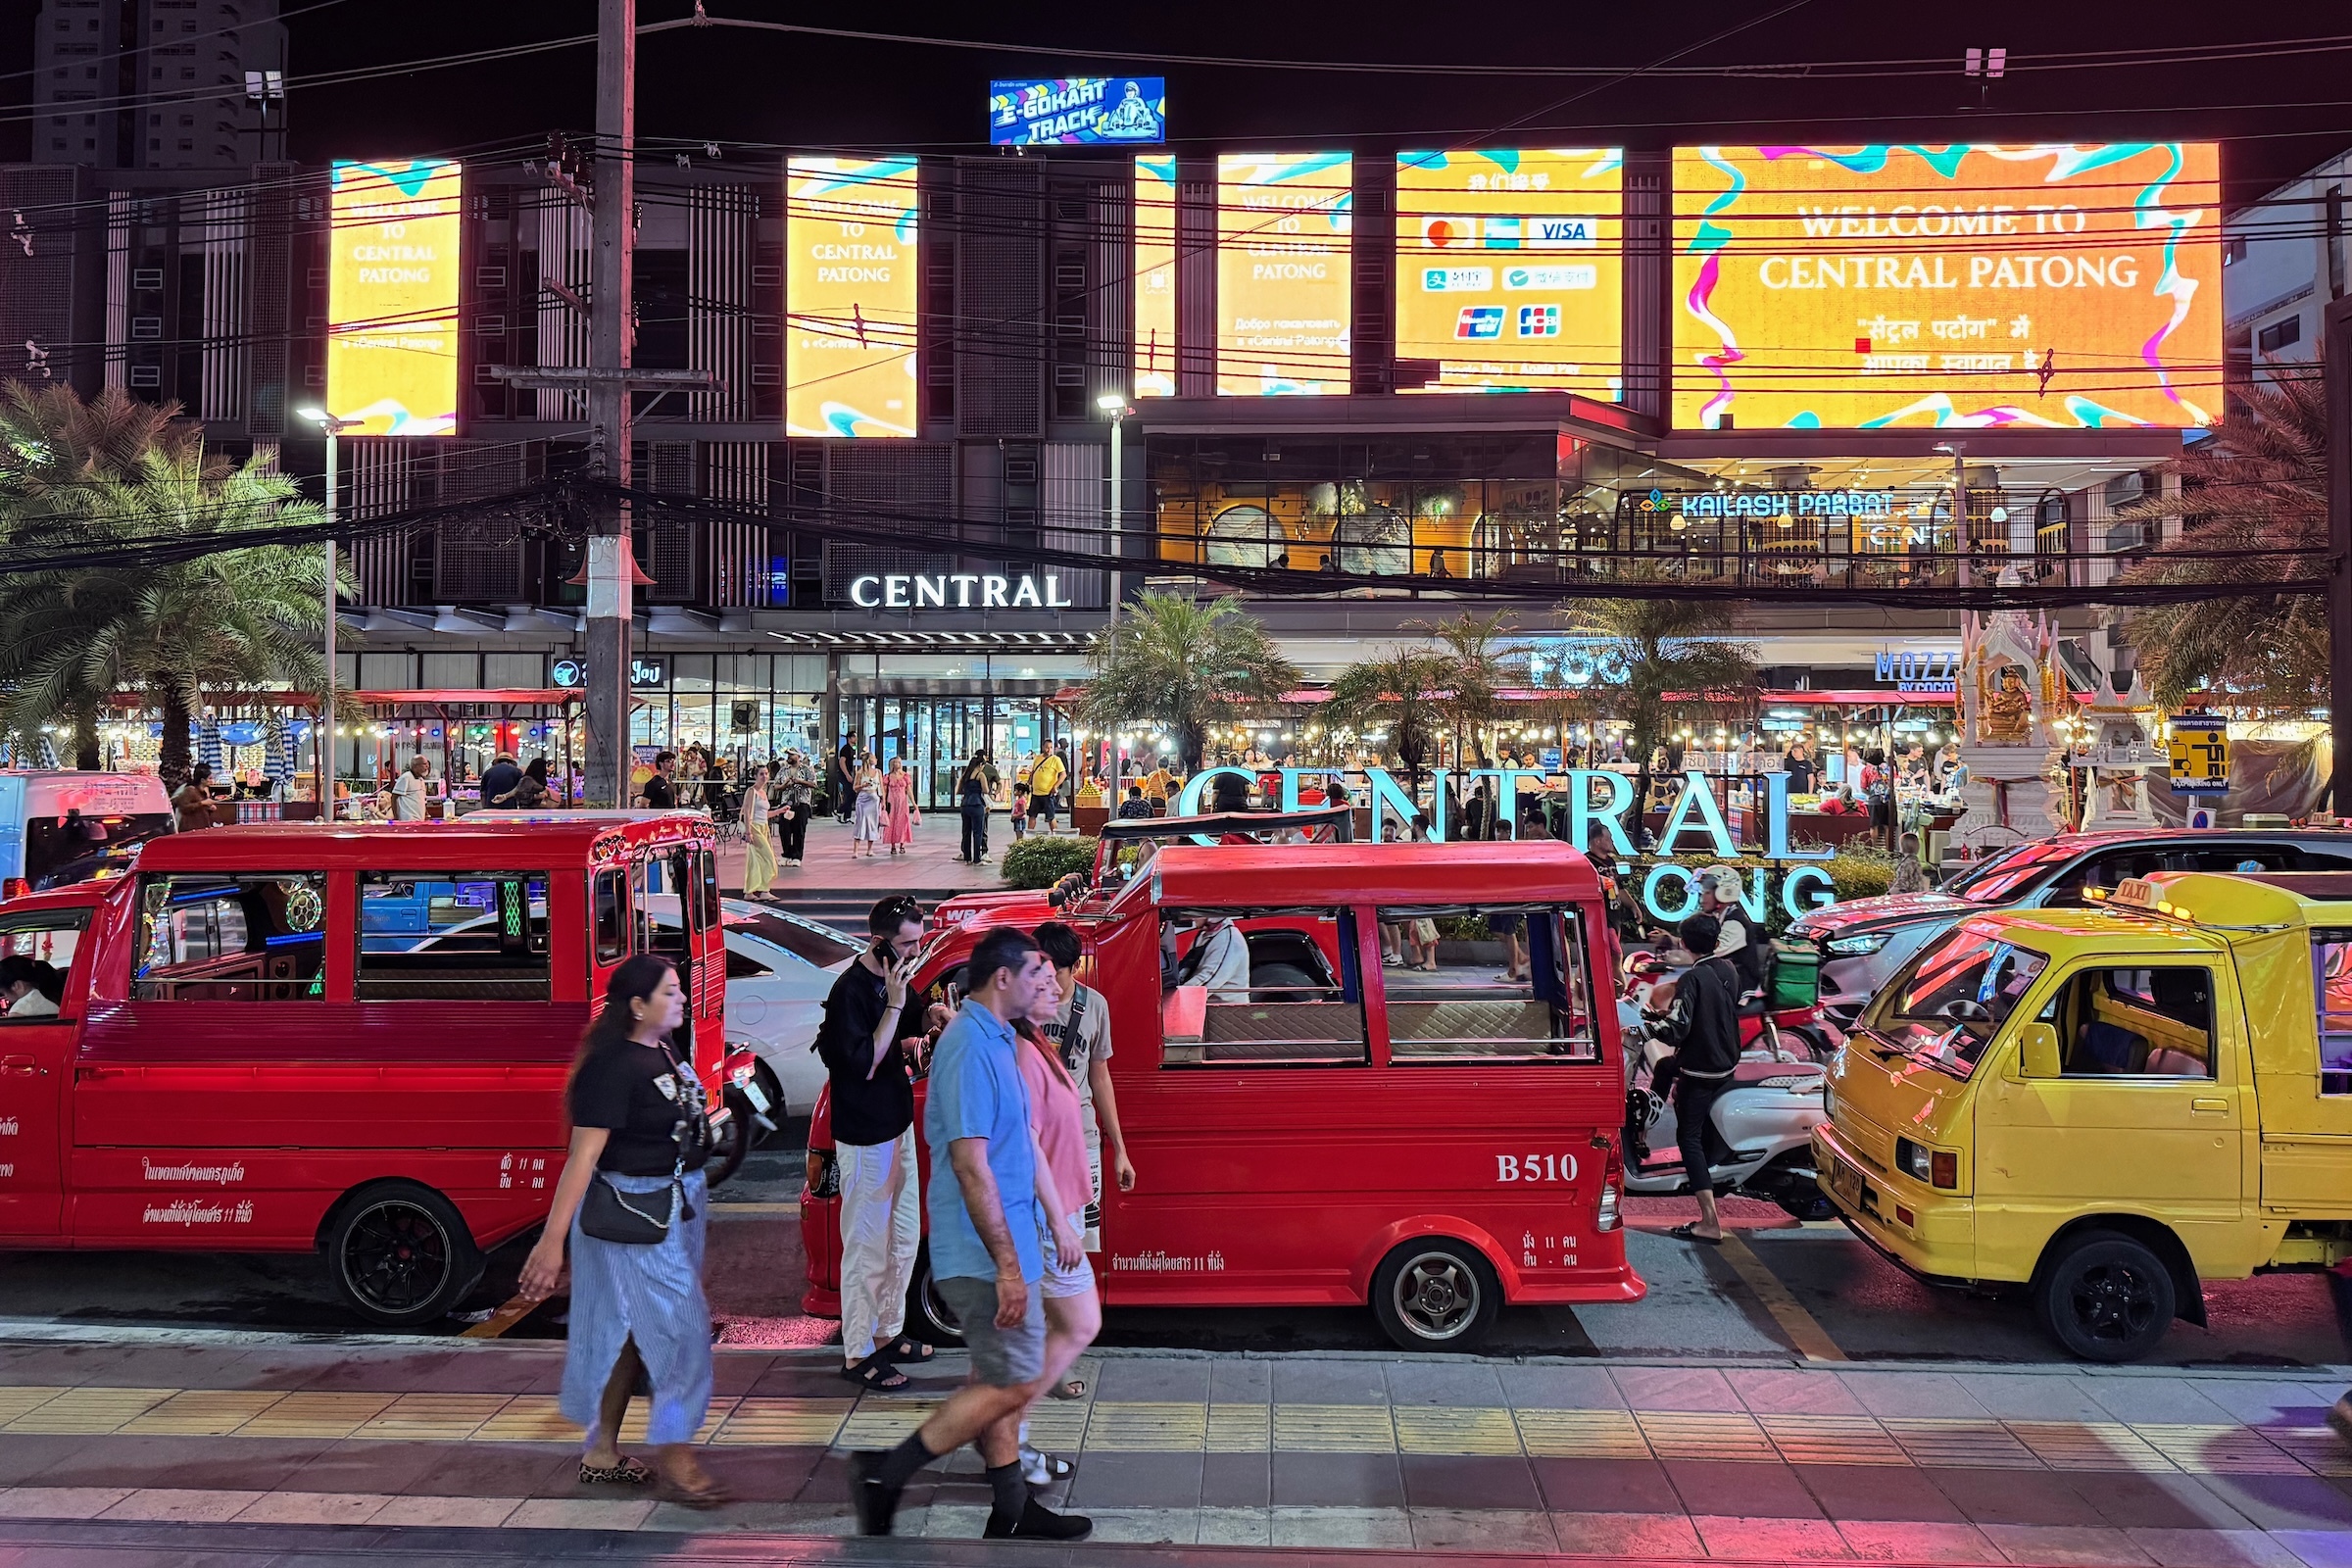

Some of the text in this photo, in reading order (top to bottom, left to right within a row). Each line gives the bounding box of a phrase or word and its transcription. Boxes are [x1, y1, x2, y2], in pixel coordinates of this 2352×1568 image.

[997, 80, 1108, 126] E-GOKART
[1028, 105, 1105, 141] TRACK
[839, 221, 864, 237] TO
[1277, 219, 1300, 233] TO
[1796, 204, 2086, 237] WELCOME TO
[380, 223, 406, 239] TO
[1542, 222, 1586, 240] VISA
[353, 246, 436, 262] CENTRAL
[811, 244, 899, 260] CENTRAL
[359, 268, 430, 283] PATONG
[817, 267, 891, 282] PATONG
[1253, 264, 1327, 280] PATONG
[1759, 254, 2139, 289] CENTRAL PATONG
[1682, 493, 1894, 517] KAILASH PARBAT
[851, 574, 1072, 608] CENTRAL
[1875, 652, 1954, 681] MOZZ
[1178, 765, 1836, 859] CENTRAL
[2120, 881, 2149, 901] TAXI
[518, 1157, 528, 1170] 11
[1495, 1153, 1578, 1182] B510
[223, 1208, 234, 1223] 11
[1522, 1229, 1577, 1249] นั่ง 11 คน
[1112, 1250, 1225, 1274] จำนวนที่นั่งผู้โดยสาร 11 ที่นั่ง
[1523, 1250, 1537, 1267] ยืน
[1563, 1254, 1578, 1266] คน
